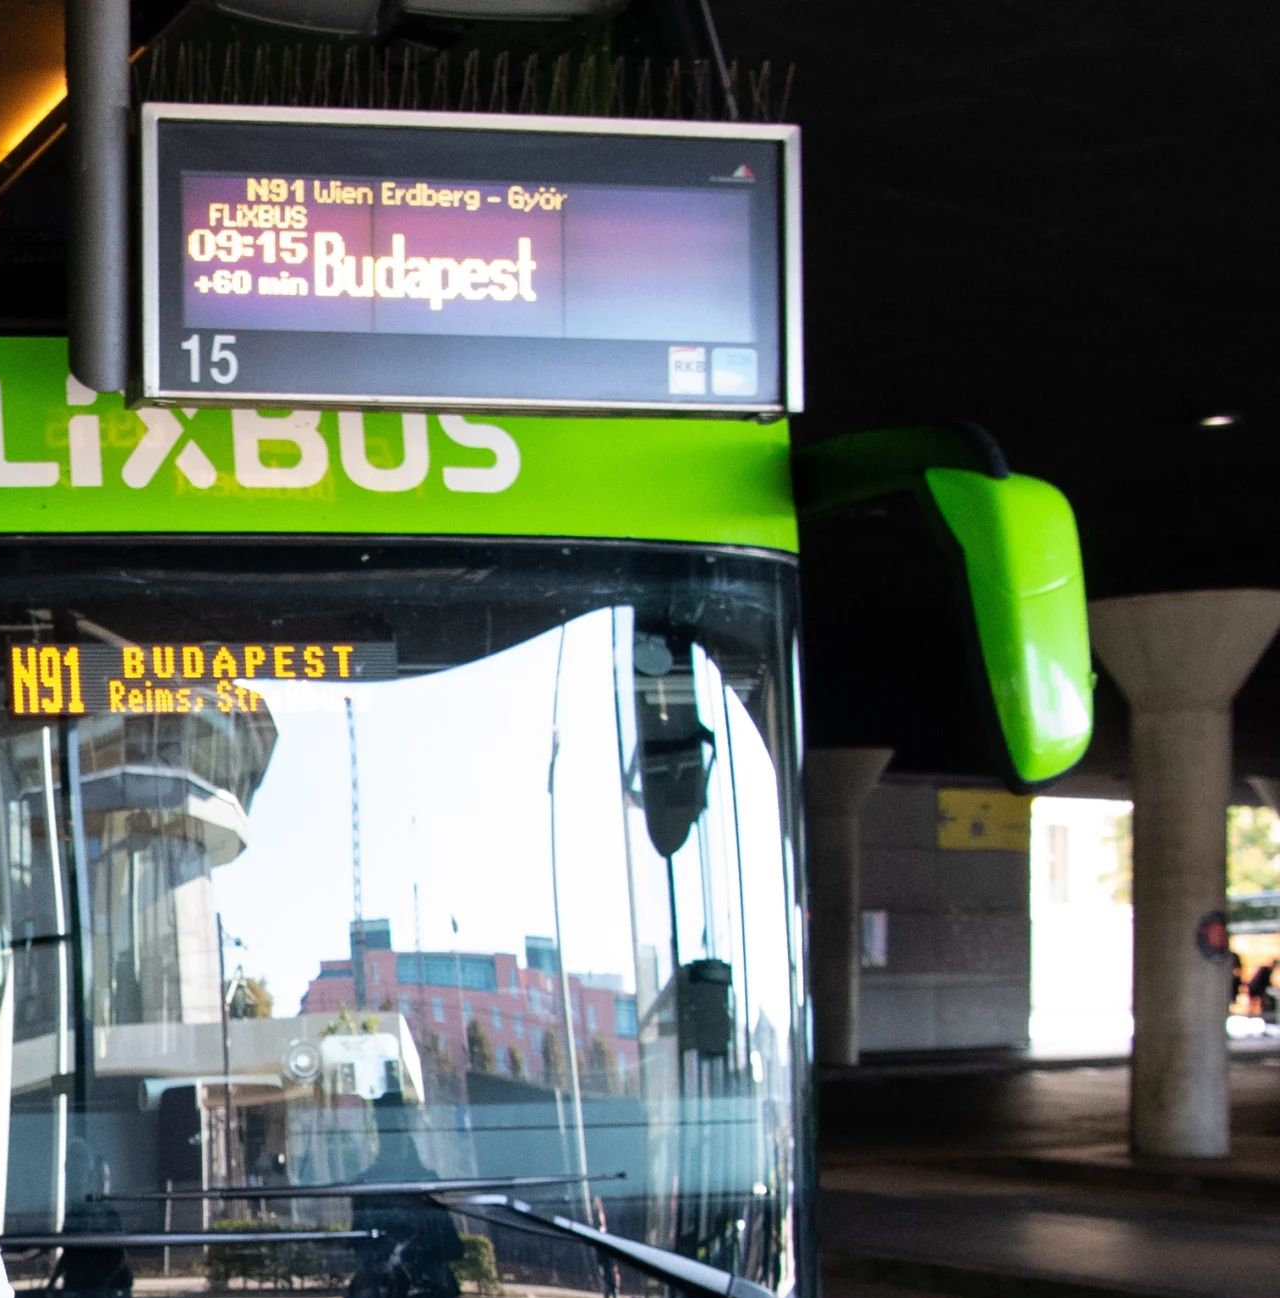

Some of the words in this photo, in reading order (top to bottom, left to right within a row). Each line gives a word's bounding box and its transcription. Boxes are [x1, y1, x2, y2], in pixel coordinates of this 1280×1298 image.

[246, 177, 305, 202] N91
[313, 179, 374, 205] Wien
[381, 181, 481, 211] Erdberg
[188, 228, 309, 264] 09:15
[314, 231, 537, 311] Budapest
[193, 269, 252, 295] +60
[258, 271, 309, 296] min
[181, 335, 239, 385] 15
[11, 646, 85, 714] N91
[122, 645, 354, 679] BUDAPEST
[108, 680, 204, 714] Reims,
